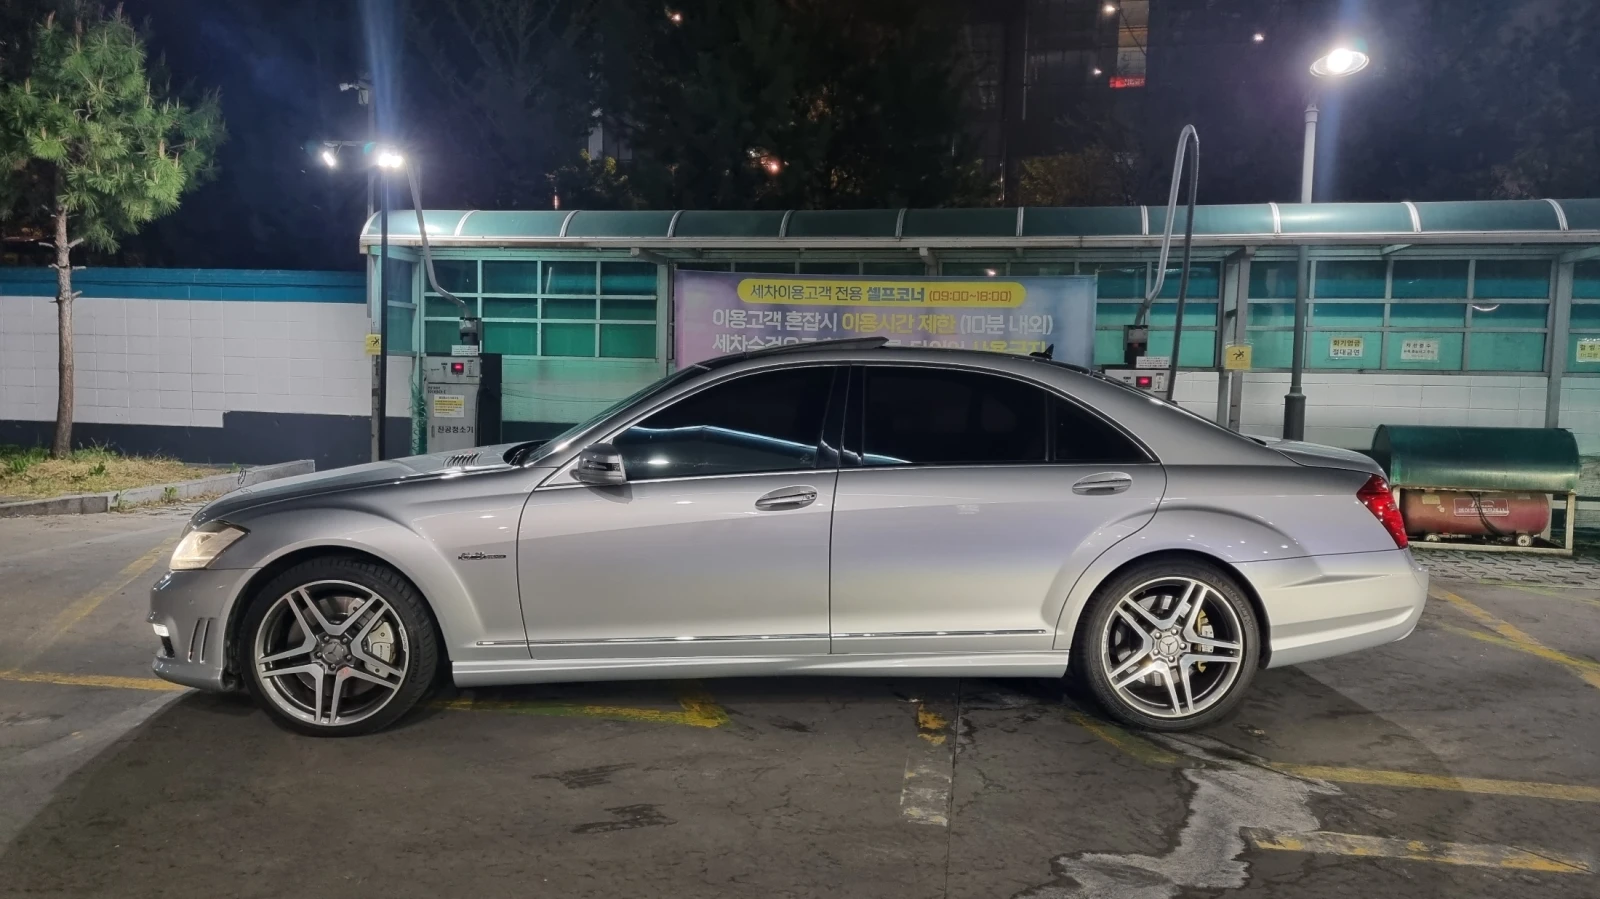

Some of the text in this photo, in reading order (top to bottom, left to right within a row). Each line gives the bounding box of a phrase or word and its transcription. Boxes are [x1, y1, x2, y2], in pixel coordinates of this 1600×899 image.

[750, 284, 1012, 302] 세차이용고객 전용 셀프코너 (09:00~18:00)
[712, 309, 1054, 335] 이용고객 혼잡시 이용시간 제한 (10분 내외)
[437, 425, 474, 434] 진공청소기
